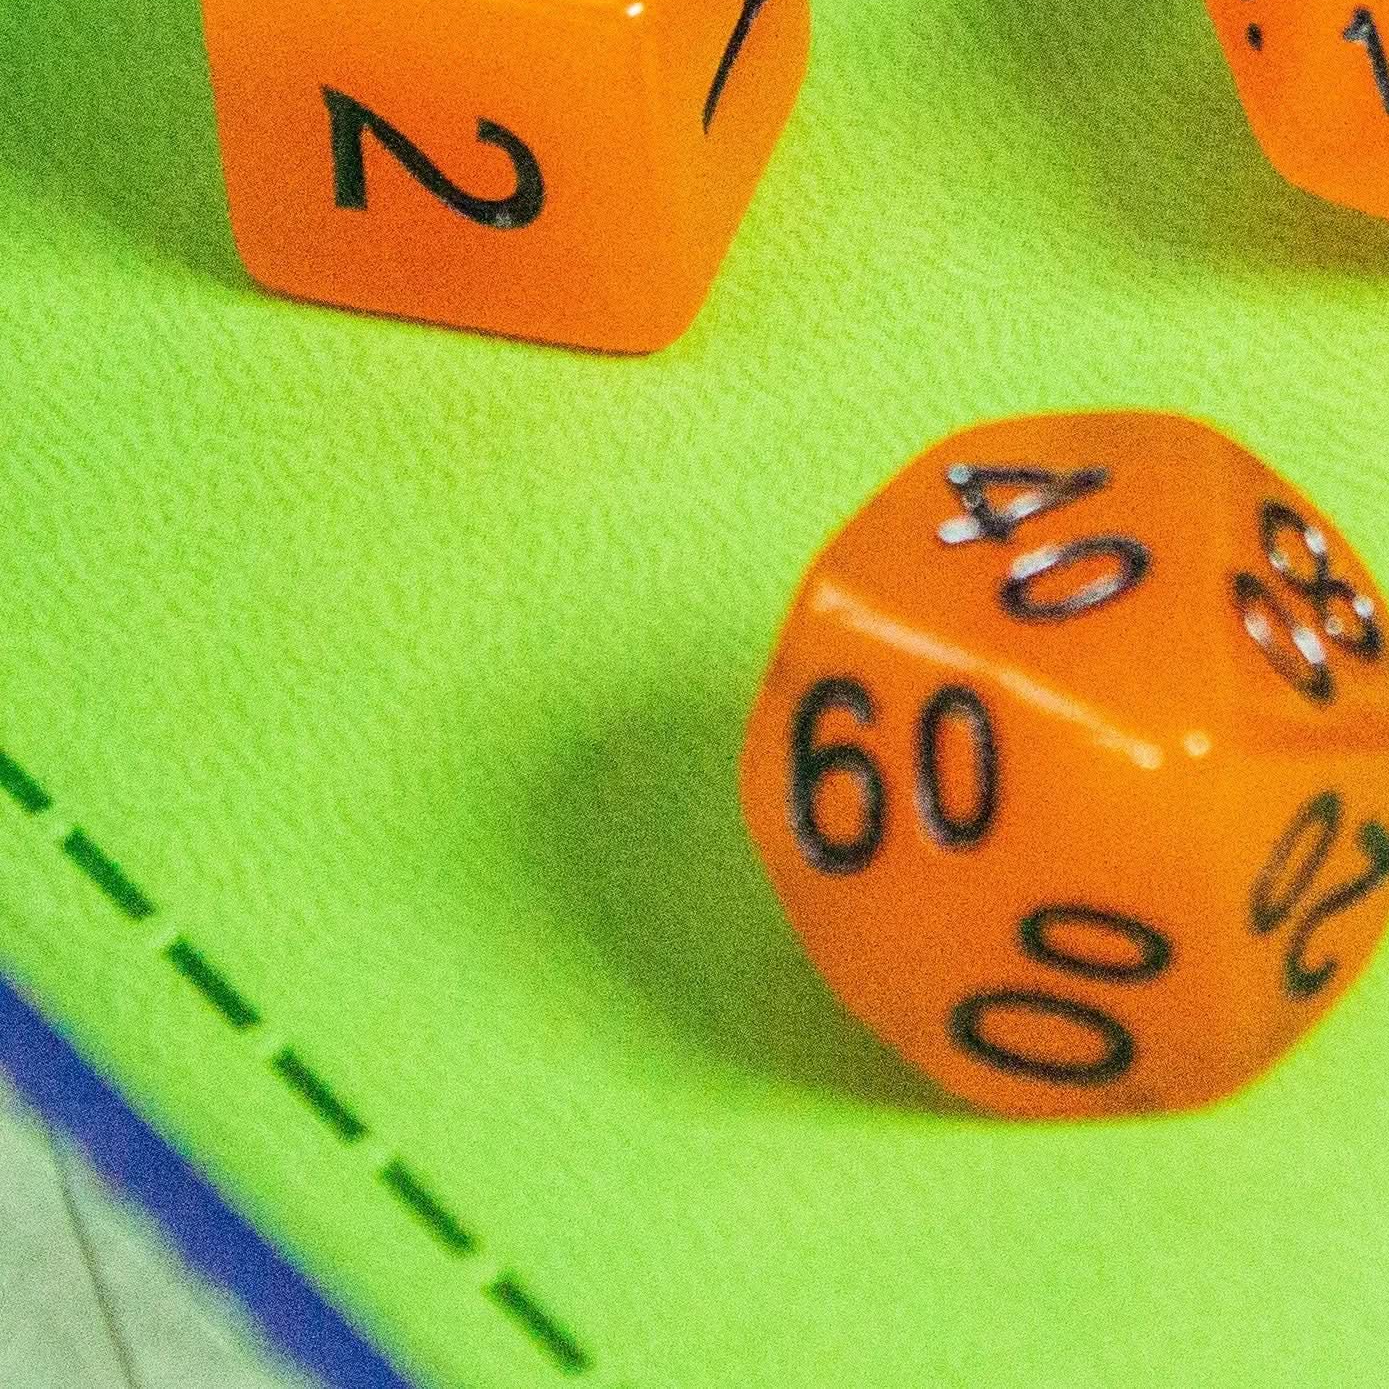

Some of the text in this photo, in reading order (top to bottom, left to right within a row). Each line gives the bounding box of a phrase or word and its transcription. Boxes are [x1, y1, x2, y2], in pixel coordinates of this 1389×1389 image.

[320, 84, 547, 231] 2
[936, 462, 1153, 626] 40
[1230, 497, 1385, 705] 80
[786, 674, 1002, 879] 60
[944, 900, 1174, 1090] 00
